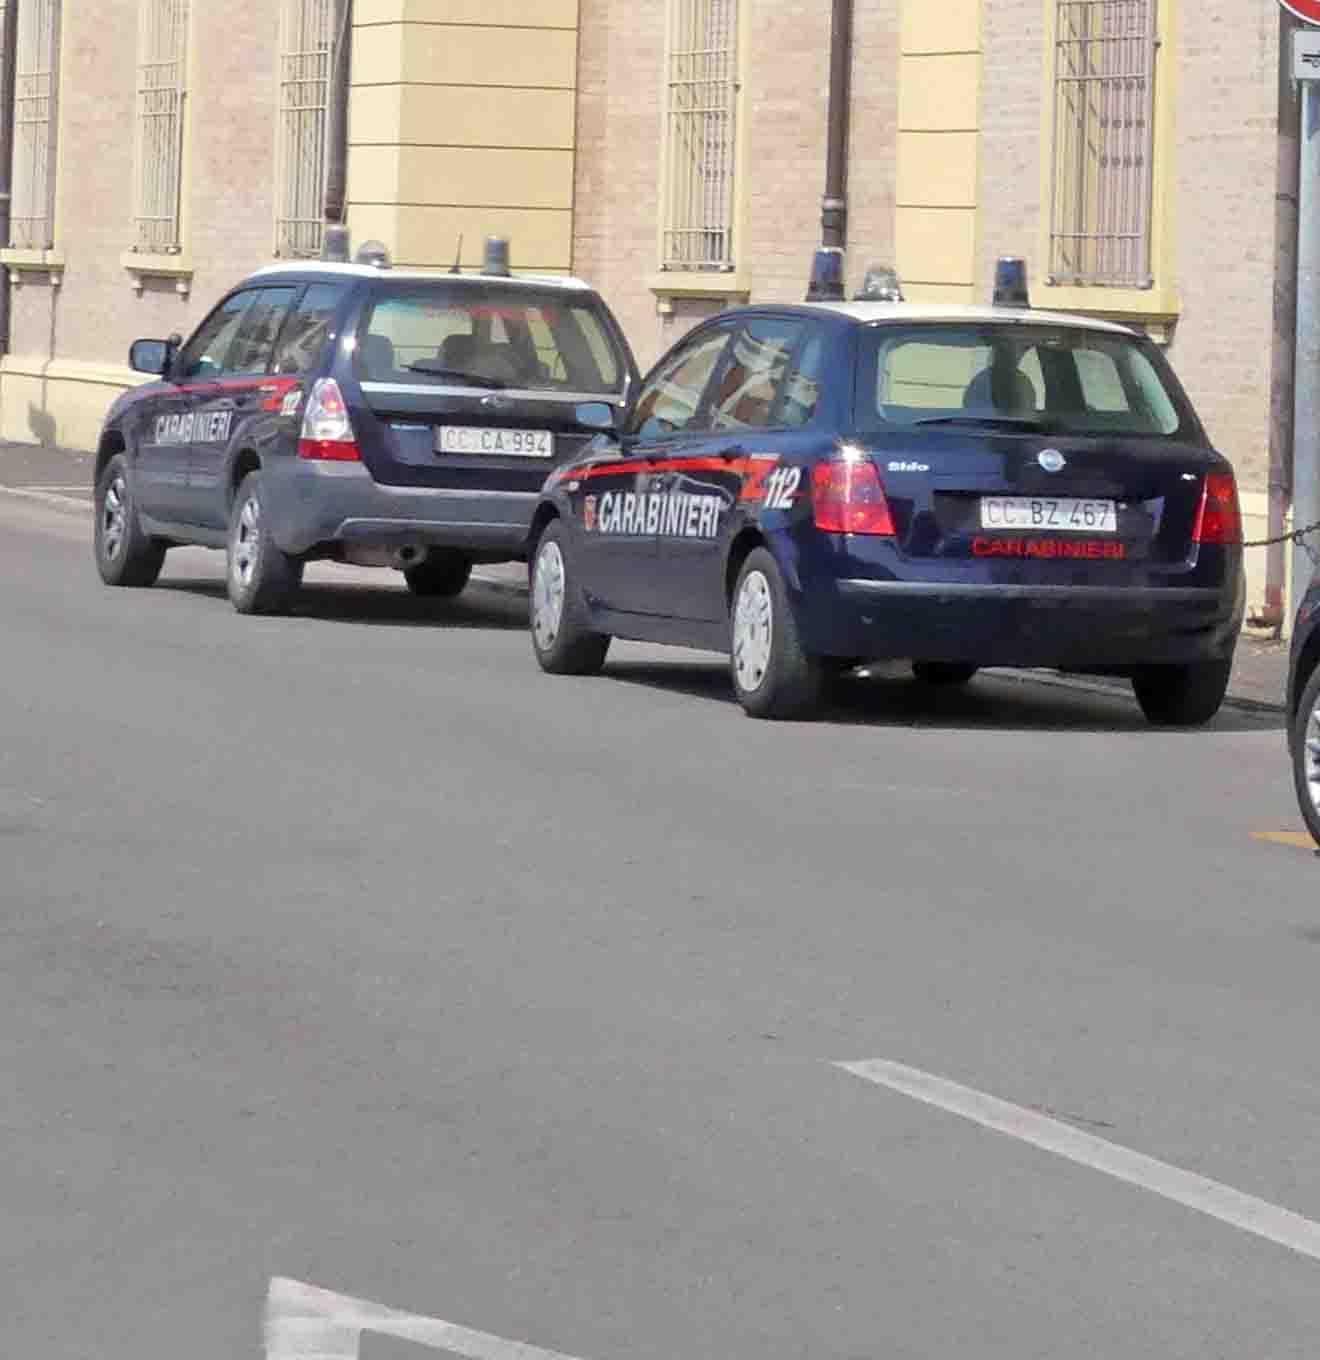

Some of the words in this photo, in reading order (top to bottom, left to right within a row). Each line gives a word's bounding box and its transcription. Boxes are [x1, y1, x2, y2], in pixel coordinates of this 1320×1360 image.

[766, 466, 801, 509] 112
[599, 491, 722, 537] CARABINIERI
[1032, 501, 1059, 524] BZ
[971, 538, 1126, 559] CARABINIERI
